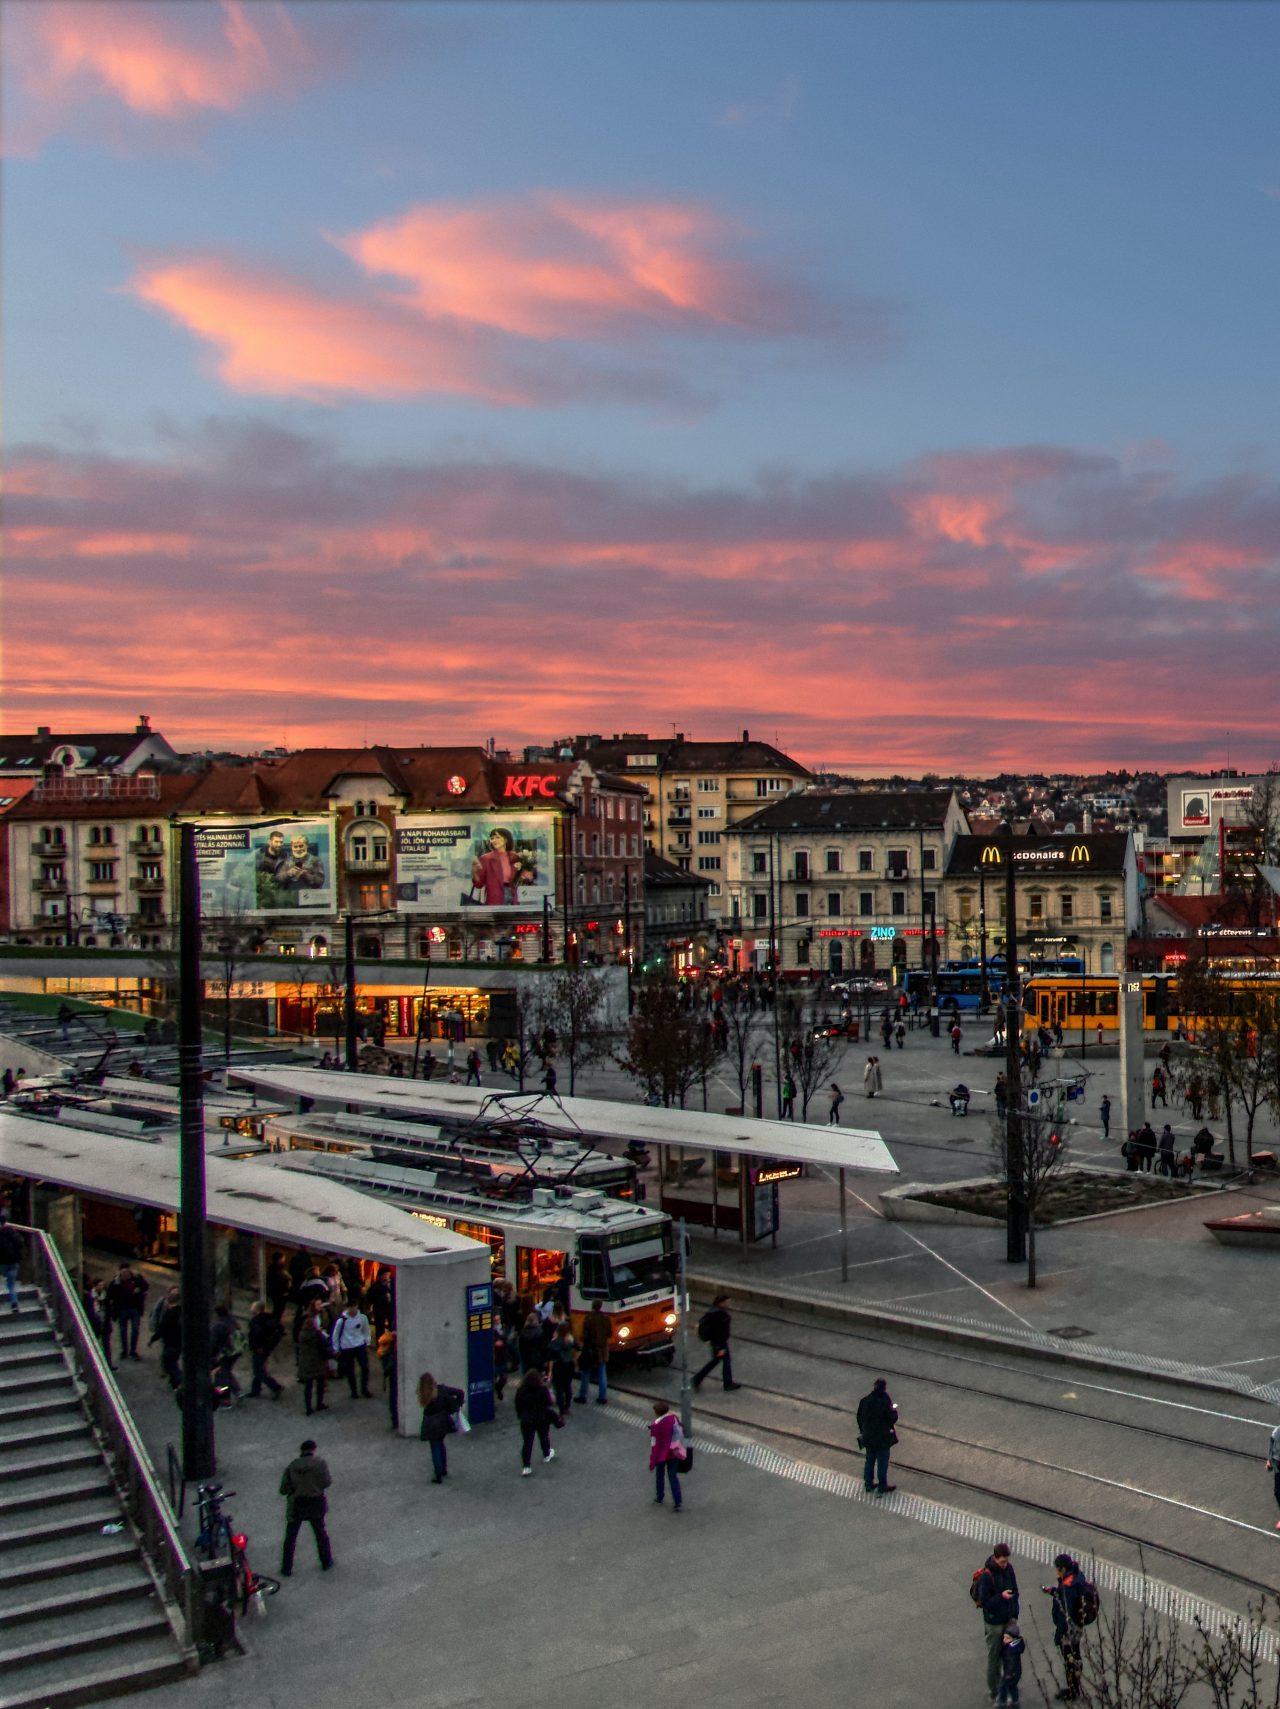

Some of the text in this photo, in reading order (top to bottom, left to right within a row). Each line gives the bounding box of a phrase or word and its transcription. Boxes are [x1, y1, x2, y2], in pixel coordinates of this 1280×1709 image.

[504, 776, 557, 797] KFC
[515, 923, 540, 934] KFC
[870, 926, 896, 937] ZING
